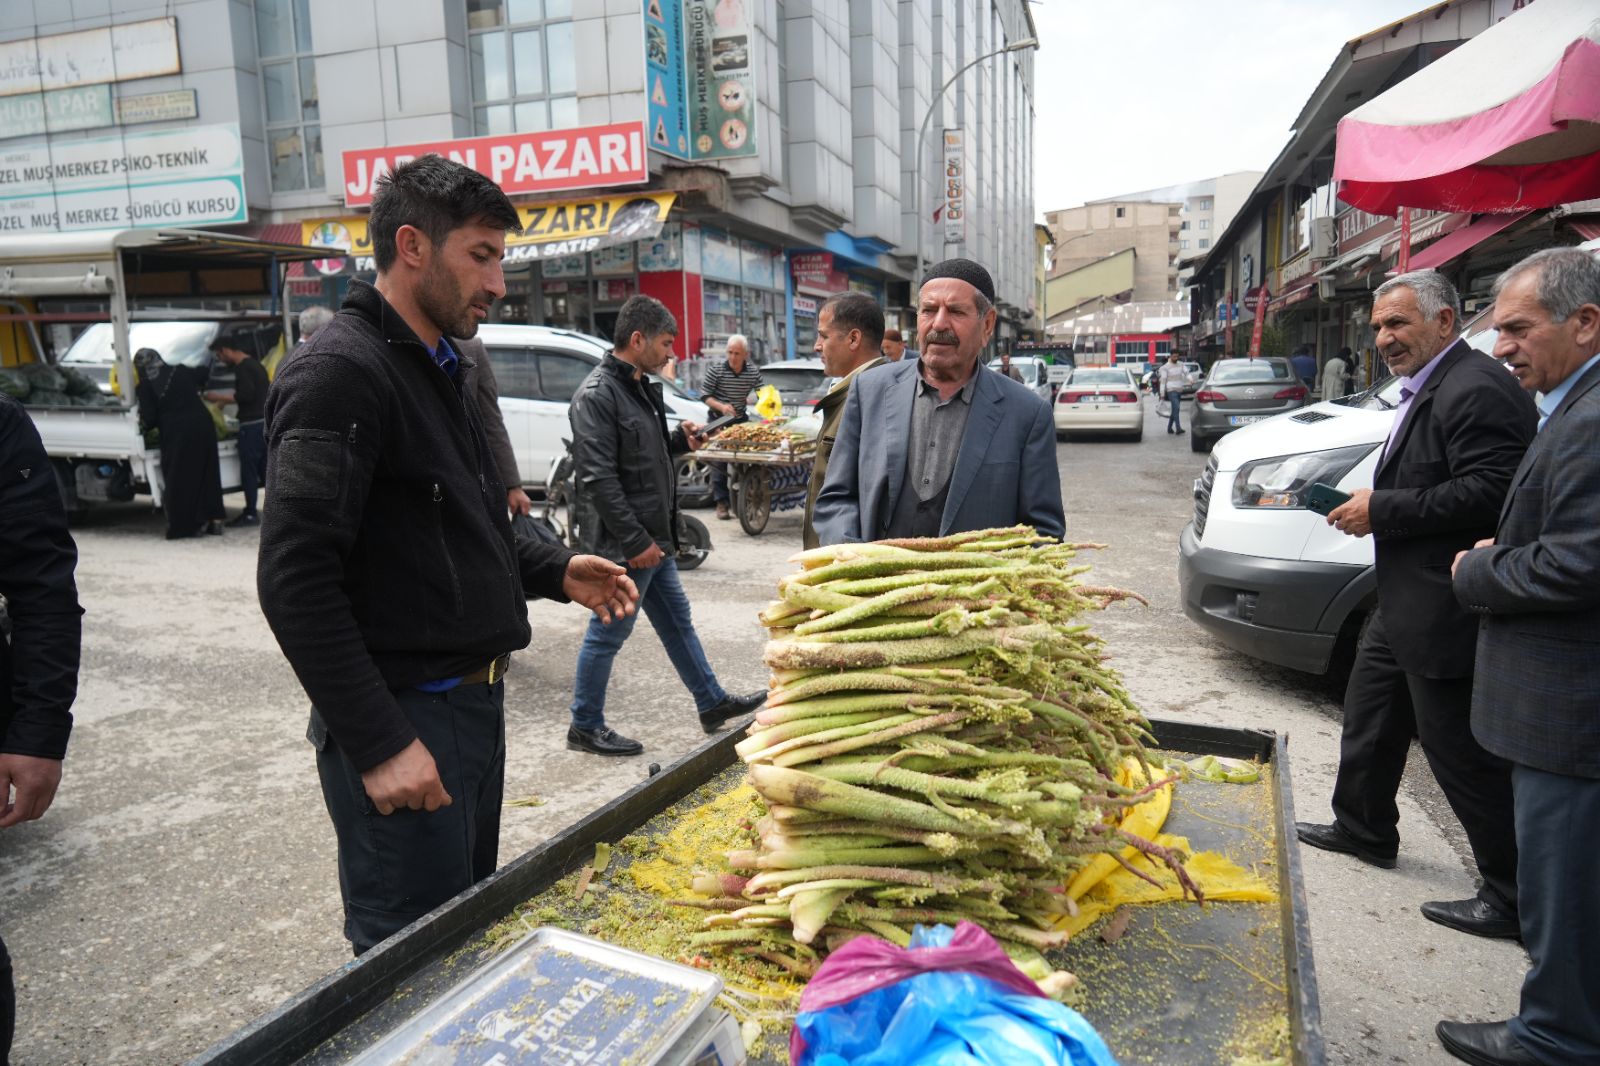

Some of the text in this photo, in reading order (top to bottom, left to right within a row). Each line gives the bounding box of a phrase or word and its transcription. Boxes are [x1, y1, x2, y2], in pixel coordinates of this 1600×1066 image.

[59, 91, 99, 115] PAR
[56, 160, 110, 178] MERKEZ
[112, 147, 208, 173] PSİKO-TEKNİK
[490, 131, 642, 184] PAZARI
[66, 207, 119, 224] MERKEZ
[125, 198, 181, 219] SÜRÜCÜ
[187, 197, 235, 214] KURSU
